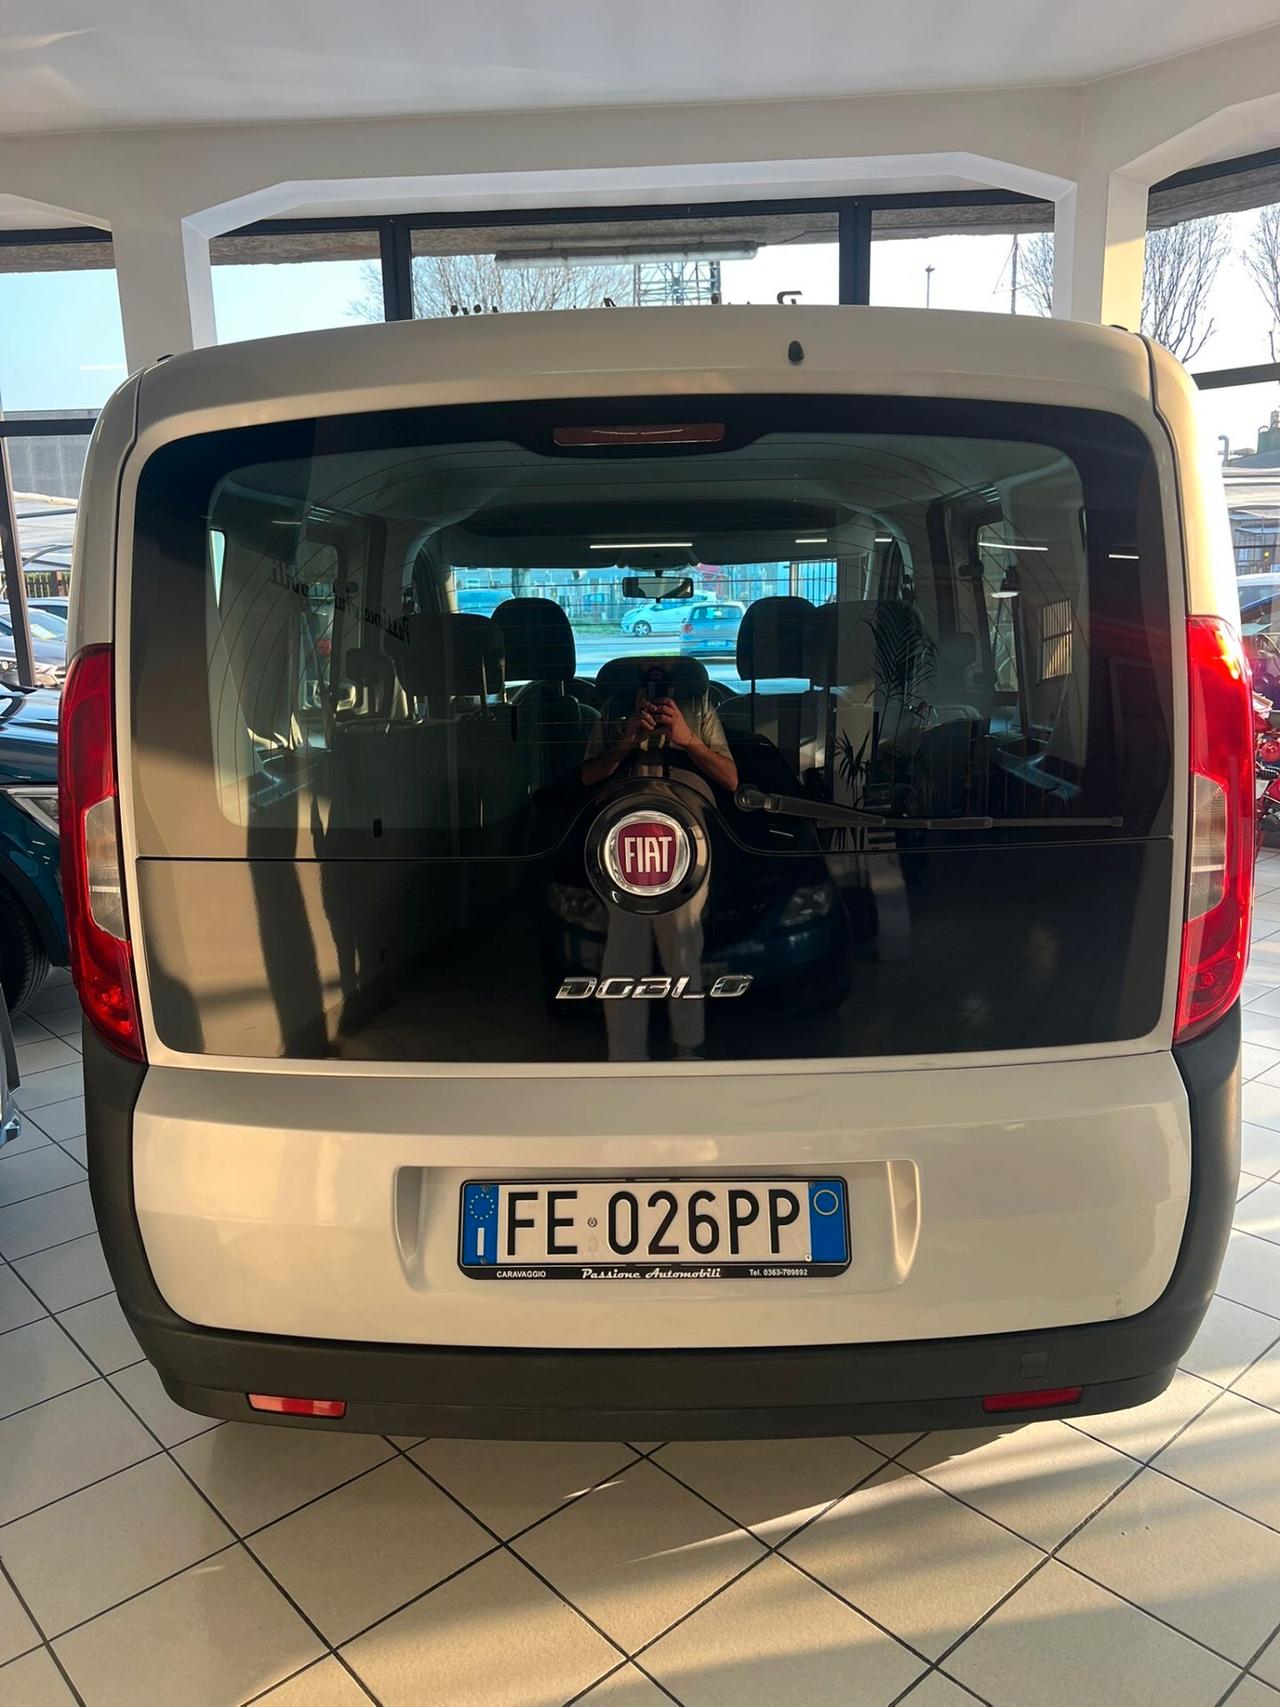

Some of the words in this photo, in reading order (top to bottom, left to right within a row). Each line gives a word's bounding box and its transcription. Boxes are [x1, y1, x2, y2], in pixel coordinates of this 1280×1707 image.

[624, 836, 672, 873] FIAT
[496, 1270, 547, 1278] CARAVAGGIO
[581, 1266, 642, 1280] Passione
[645, 1266, 721, 1279] Automobili
[749, 1268, 762, 1277] Tel.
[763, 1268, 809, 1277] 0363-709892
